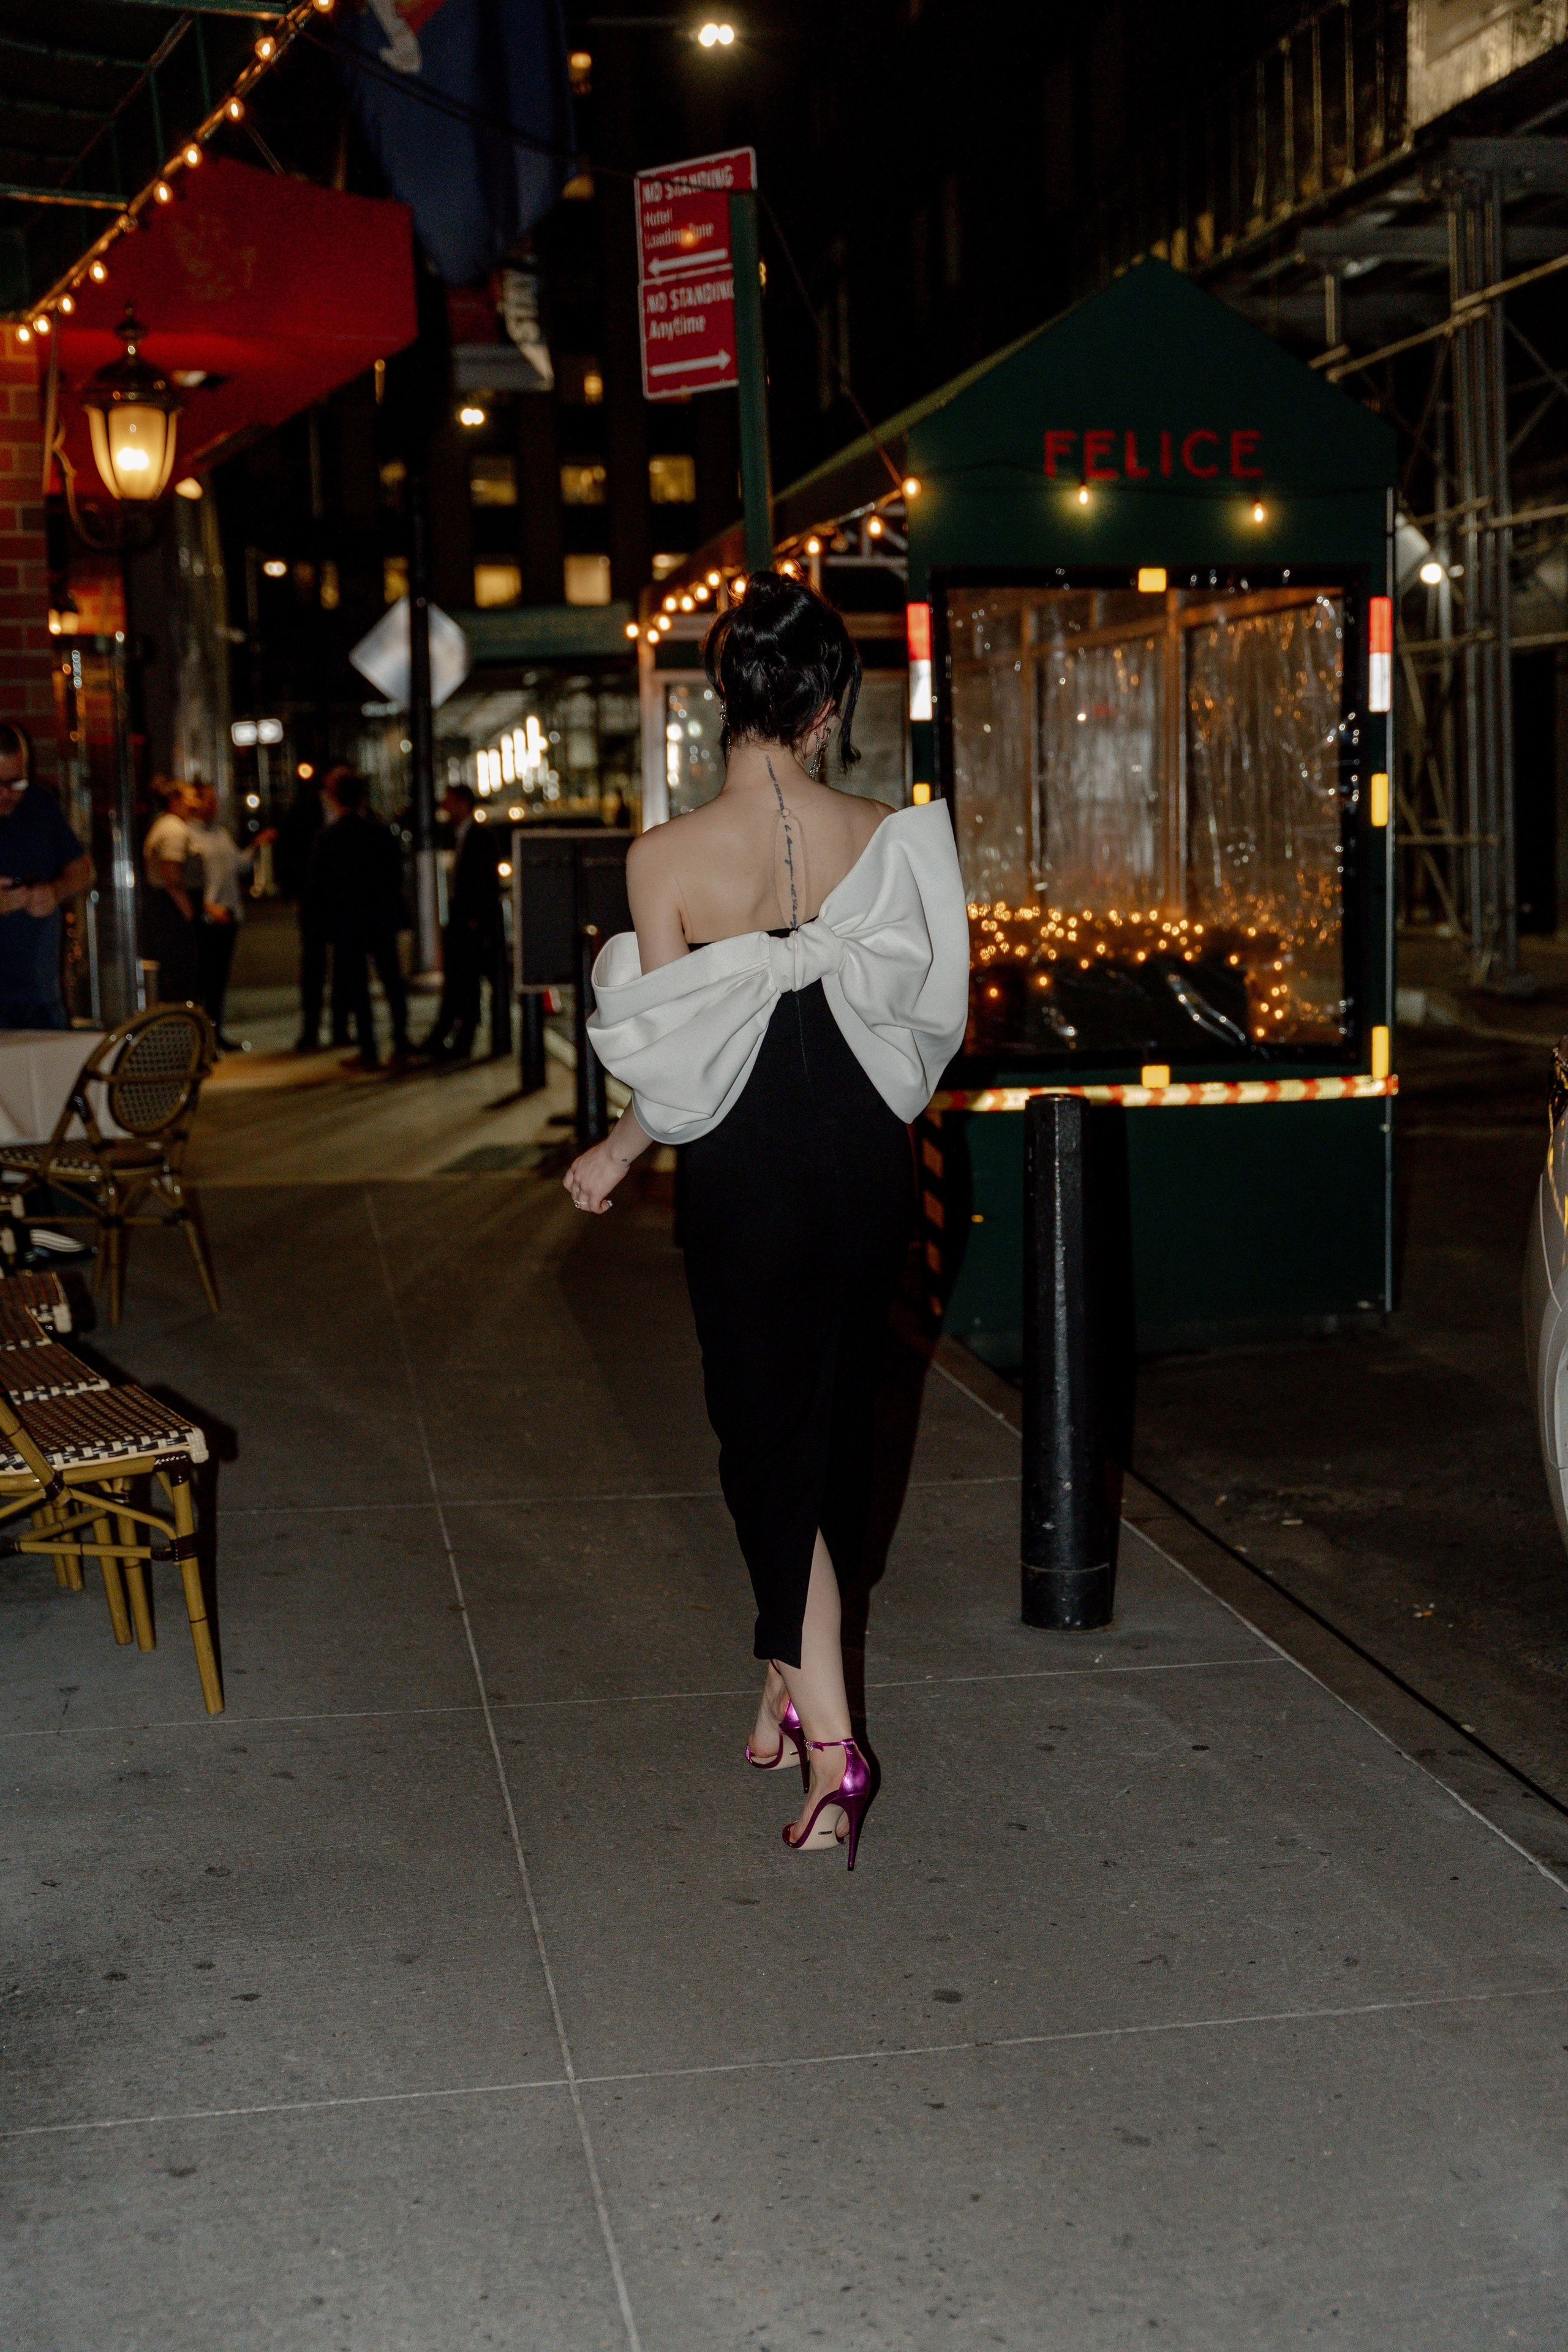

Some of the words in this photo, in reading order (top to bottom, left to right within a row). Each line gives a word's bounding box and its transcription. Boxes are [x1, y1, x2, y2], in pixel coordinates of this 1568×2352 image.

[643, 181, 663, 204] NO
[664, 165, 734, 201] STANDING
[647, 291, 668, 314] NO
[648, 314, 706, 341] Anytime
[1044, 429, 1264, 480] FELICE
